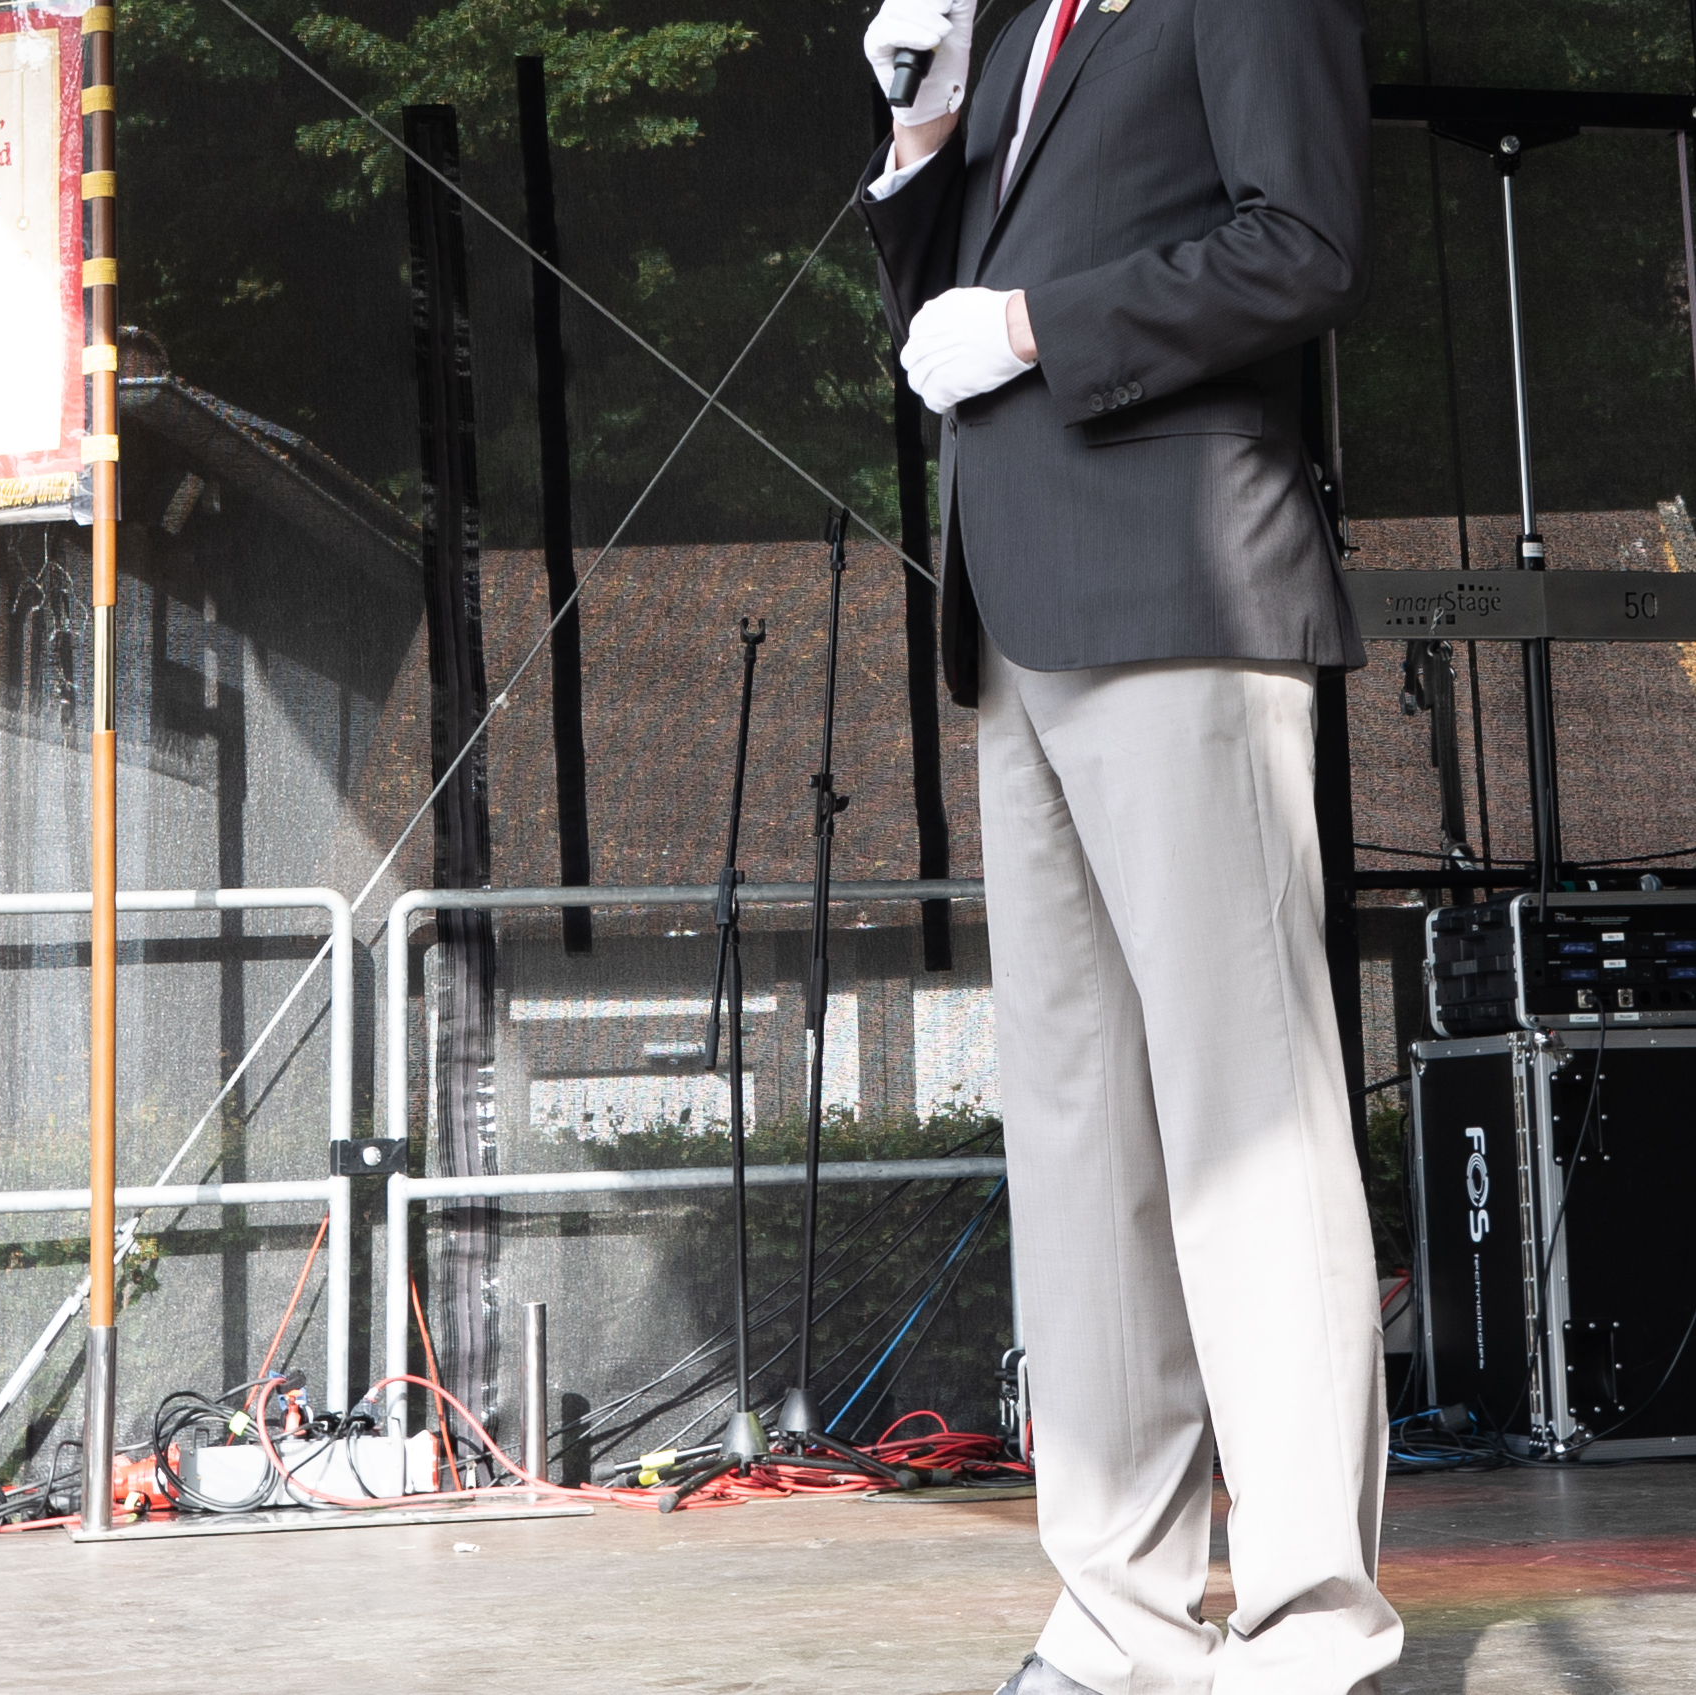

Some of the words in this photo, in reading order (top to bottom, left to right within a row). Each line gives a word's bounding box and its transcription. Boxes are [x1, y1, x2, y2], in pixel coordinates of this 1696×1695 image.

[1623, 591, 1658, 619] 50
[1465, 1127, 1490, 1242] FOS
[1473, 1253, 1485, 1370] technologies
